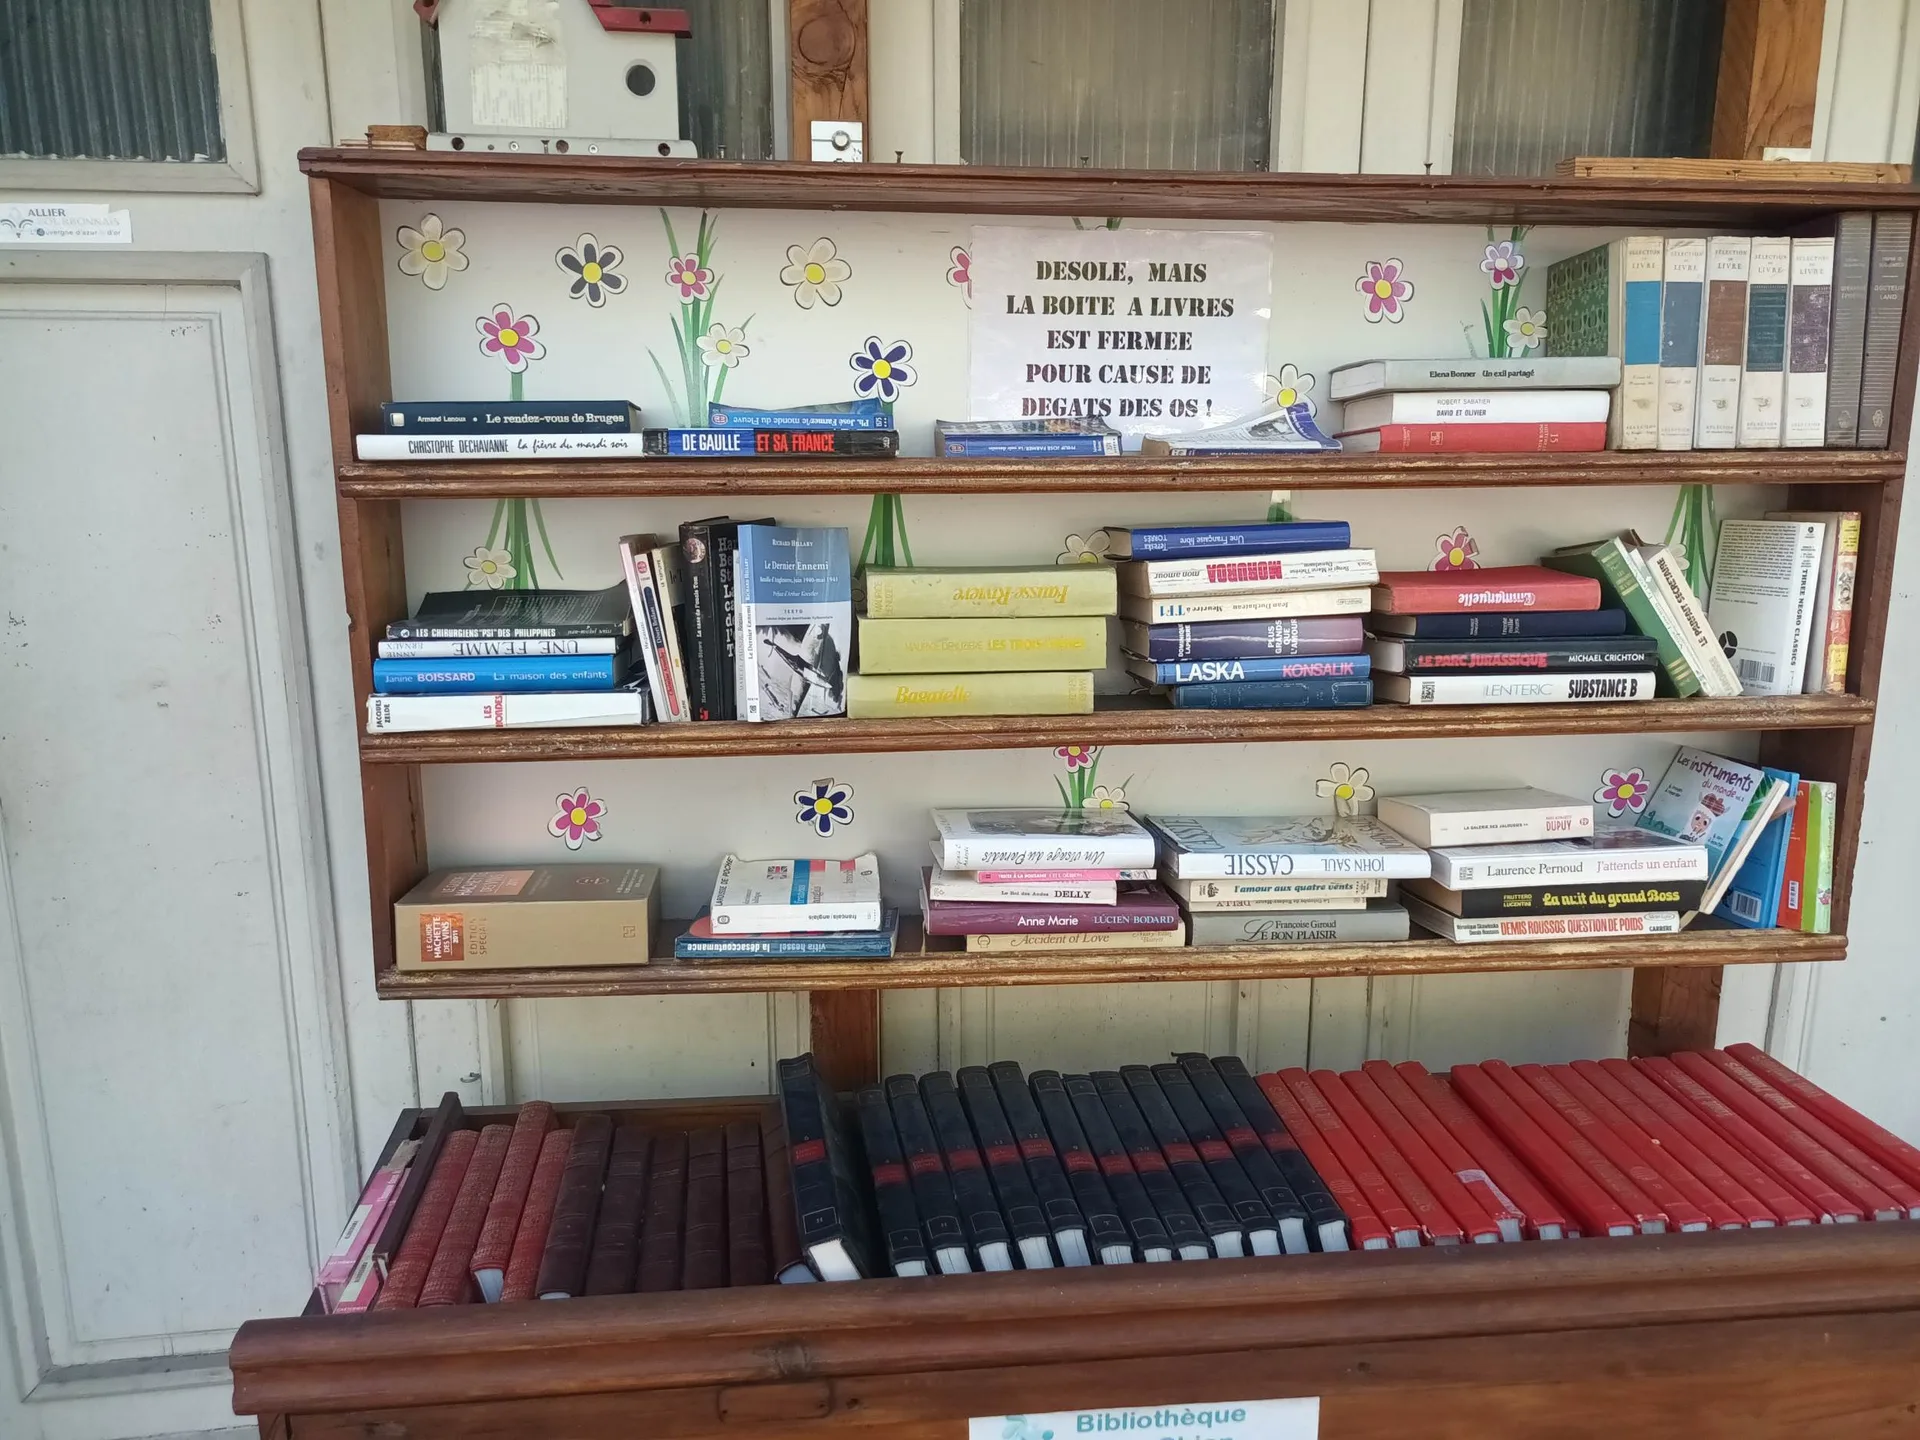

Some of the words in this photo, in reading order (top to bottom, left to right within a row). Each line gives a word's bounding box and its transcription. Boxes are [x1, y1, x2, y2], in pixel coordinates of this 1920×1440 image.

[28, 208, 66, 217] ALLIER
[1036, 261, 1133, 285] DESOLE,
[1148, 262, 1207, 284] MAIS
[1006, 295, 1035, 315] LA
[1042, 295, 1115, 316] BOITE
[1127, 297, 1143, 317] A
[1150, 297, 1234, 318] LIVRES
[1047, 330, 1091, 350] EST
[1097, 331, 1193, 351] FERMEE
[1026, 363, 1092, 384] POUR
[1098, 365, 1174, 385] CAUSE
[1180, 365, 1211, 385] DE
[1508, 369, 1535, 379] partagé
[1021, 398, 1112, 418] DEGATS
[1119, 398, 1162, 418] DES
[1169, 398, 1198, 418] OS
[1206, 398, 1213, 418] !
[486, 414, 501, 424] Le
[503, 413, 570, 424] rendez-vous
[572, 413, 585, 424] de
[586, 413, 624, 426] Bruges
[733, 416, 760, 424] Fleuve
[838, 418, 856, 426] José
[408, 439, 454, 454] CHRISTOPHE
[459, 438, 509, 454] DECHAVANNE
[532, 438, 557, 454] fièvre
[559, 438, 572, 449] du
[576, 438, 607, 449] mardi
[610, 438, 628, 449] soir
[682, 434, 698, 451] DE
[700, 434, 740, 451] GAULLE
[756, 434, 770, 452] ET
[772, 434, 788, 452] SA
[792, 432, 834, 452] FRANCE
[1196, 535, 1228, 544] Française
[1229, 534, 1244, 544] Une
[765, 560, 771, 570] Le
[772, 560, 796, 570] Dernier
[797, 561, 829, 570] Ennemi
[1206, 560, 1282, 583] MORUROA
[1155, 571, 1181, 580] amour
[1656, 557, 1686, 604] SECRETAIRE
[1800, 569, 1808, 596] THREE
[952, 584, 1070, 606] Fausse-Rivière
[1458, 590, 1536, 606] Emmanuelle
[1160, 604, 1186, 617] TF1
[1796, 598, 1804, 626] NEGRO
[1680, 604, 1702, 637] PARFAIT
[416, 628, 428, 638] LES
[431, 628, 479, 638] CHIRURGIENS
[498, 628, 510, 637] DES
[514, 628, 556, 637] PHILIPPINES
[454, 641, 528, 656] FEMME
[538, 640, 579, 653] UNE
[1698, 636, 1708, 647] LE
[1790, 628, 1800, 666] CLASSICS
[1469, 652, 1548, 668] JURASSIQUE
[1568, 654, 1603, 662] MICHAEL
[1604, 653, 1645, 662] CRICHTON
[385, 674, 413, 683] Janine
[417, 672, 476, 682] BOISSARD
[494, 672, 505, 680] La
[510, 672, 545, 680] maison
[550, 671, 567, 680] des
[572, 670, 608, 680] enfants
[1175, 661, 1245, 682] LASKA
[1282, 662, 1354, 678] KONSALIK
[896, 685, 971, 704] Bagatelle
[1568, 678, 1628, 698] SUBSTANCE
[1629, 679, 1638, 697] B
[1677, 753, 1690, 766] Les
[1689, 755, 1754, 792] instruments
[1702, 779, 1712, 788] du
[1712, 784, 1736, 798] monde
[1546, 820, 1572, 832] DUPUY
[982, 850, 1027, 865] Paradis
[1028, 851, 1044, 865] du
[1046, 848, 1082, 864] visage
[1084, 851, 1105, 865] Un
[1354, 856, 1385, 872] JOHN
[722, 856, 734, 877] POCHE
[1224, 854, 1294, 876] CASSIE
[1320, 858, 1352, 872] SAUL
[1487, 864, 1536, 876] Laurence
[1538, 862, 1584, 875] Pernoud
[1597, 860, 1644, 873] J'attends
[1646, 861, 1661, 870] un
[1662, 858, 1698, 869] enfant
[721, 877, 728, 886] DE
[1234, 884, 1272, 894] l'amour
[1294, 884, 1326, 893] quatre
[1328, 882, 1354, 891] vents
[714, 885, 727, 906] LAROUSSE
[1054, 890, 1091, 898] DELLY
[1561, 891, 1586, 905] nuit
[1590, 890, 1606, 905] du
[1608, 890, 1646, 908] grand
[1648, 889, 1680, 902] Boss
[1017, 916, 1044, 926] Anne
[1048, 915, 1078, 926] Marie
[1133, 915, 1174, 924] BODARD
[1276, 920, 1308, 930] Françoise
[1310, 920, 1336, 928] Giroud
[1501, 920, 1527, 936] DEMIS
[1528, 918, 1566, 934] ROUSSOS
[1567, 918, 1608, 934] QUESTION
[1608, 917, 1619, 932] DE
[1619, 916, 1644, 932] POIDS
[434, 916, 442, 958] HACHETTE
[1010, 934, 1069, 946] Accident
[1071, 934, 1080, 944] of
[1082, 933, 1110, 944] Love
[1270, 932, 1294, 941] BON
[1296, 930, 1337, 940] PLAISIR
[427, 944, 432, 952] LE
[688, 942, 760, 952] désaccoutumance
[762, 943, 770, 952] la
[1076, 1408, 1246, 1433] Bibliothèque
